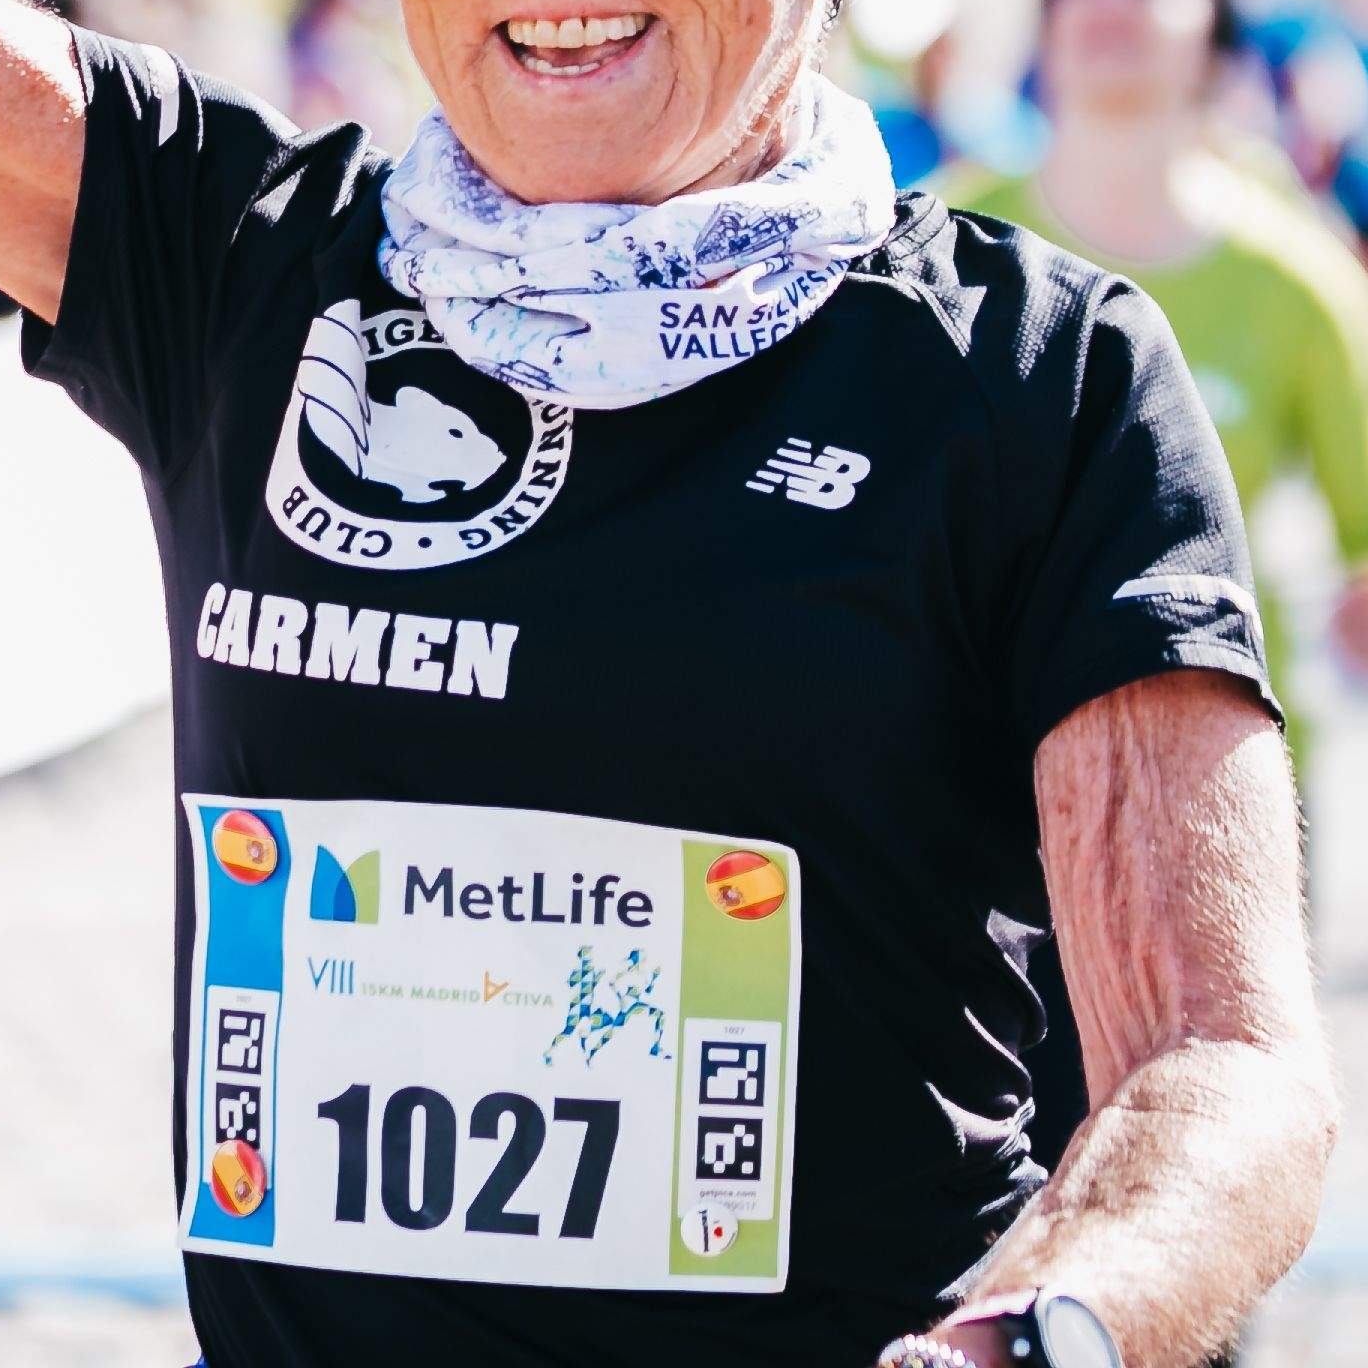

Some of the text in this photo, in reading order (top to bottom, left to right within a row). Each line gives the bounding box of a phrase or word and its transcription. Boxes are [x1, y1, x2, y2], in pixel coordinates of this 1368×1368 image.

[659, 321, 794, 360] VALLEC
[660, 302, 739, 328] SAN
[282, 399, 572, 558] UNNING CLUB
[197, 581, 520, 700] CARMEN
[403, 865, 654, 928] MetLife
[308, 957, 355, 995] VIII
[410, 986, 480, 1004] MADRID
[317, 1083, 622, 1239] 1027
